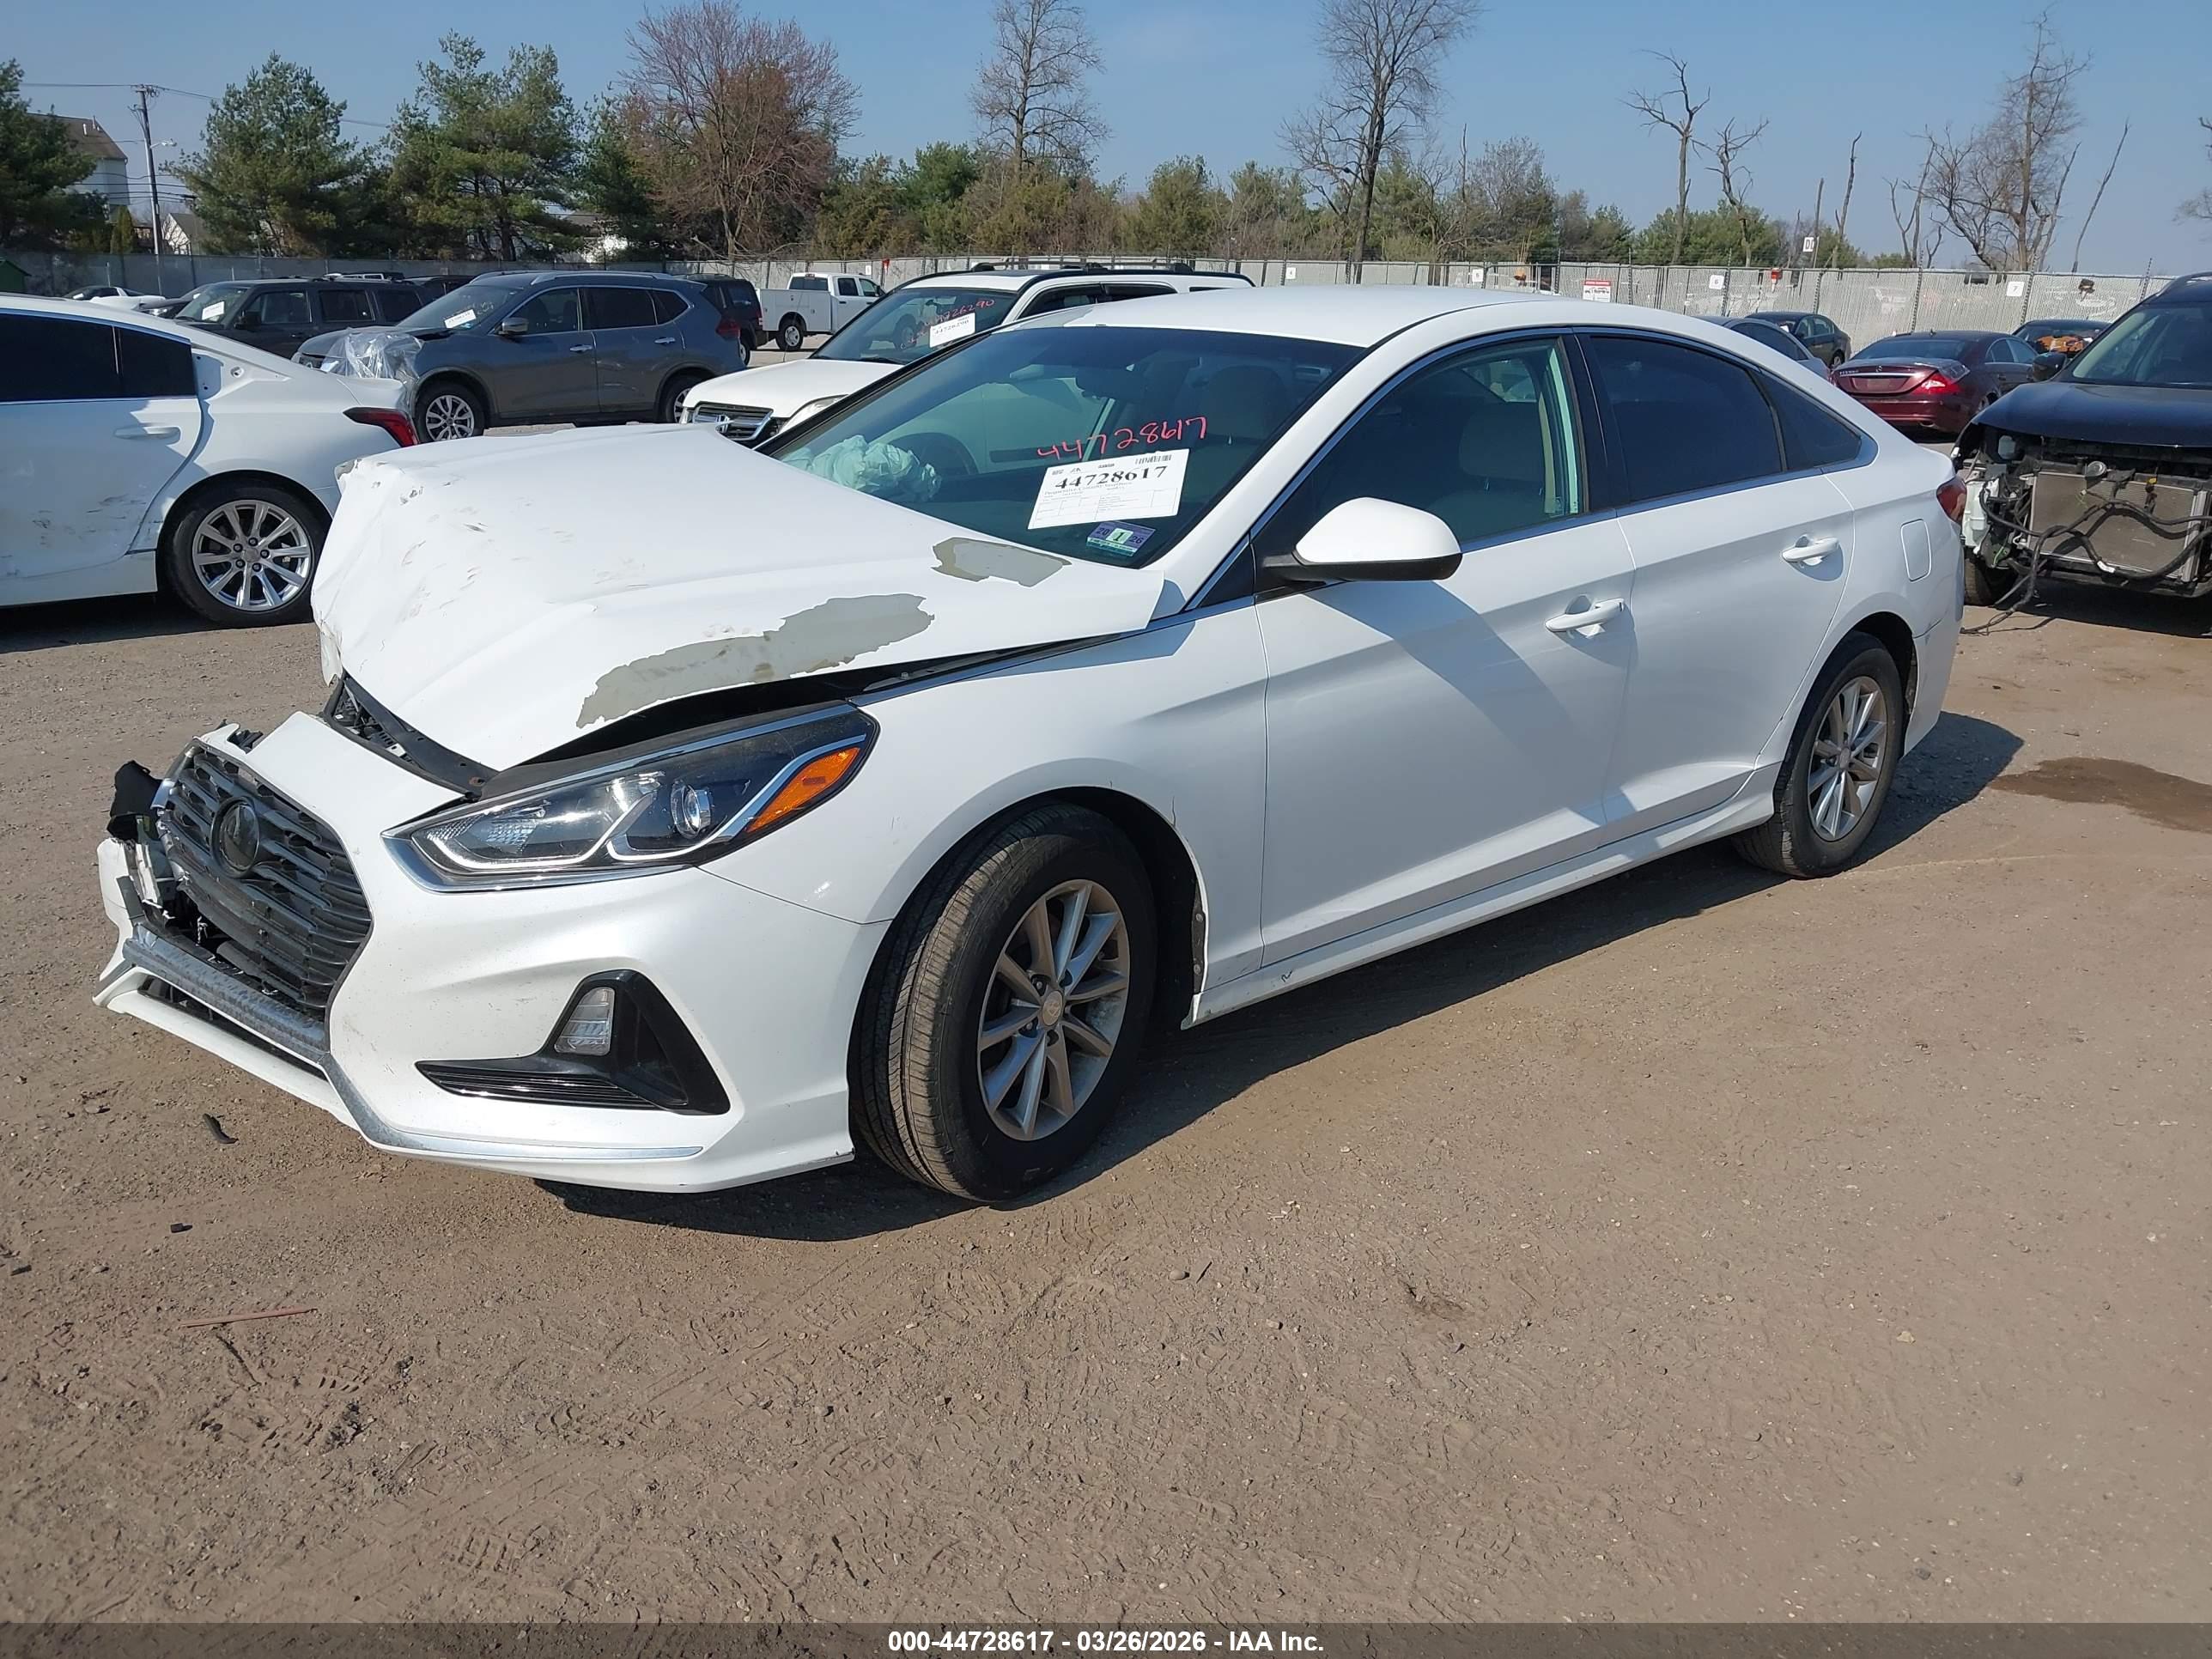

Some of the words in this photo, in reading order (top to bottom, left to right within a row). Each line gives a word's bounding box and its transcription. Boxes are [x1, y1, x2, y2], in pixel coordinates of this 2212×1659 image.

[1036, 416, 1207, 461] 44728617
[1054, 465, 1168, 489] 44728617
[1096, 527, 1110, 536] 20
[1113, 532, 1126, 542] 1
